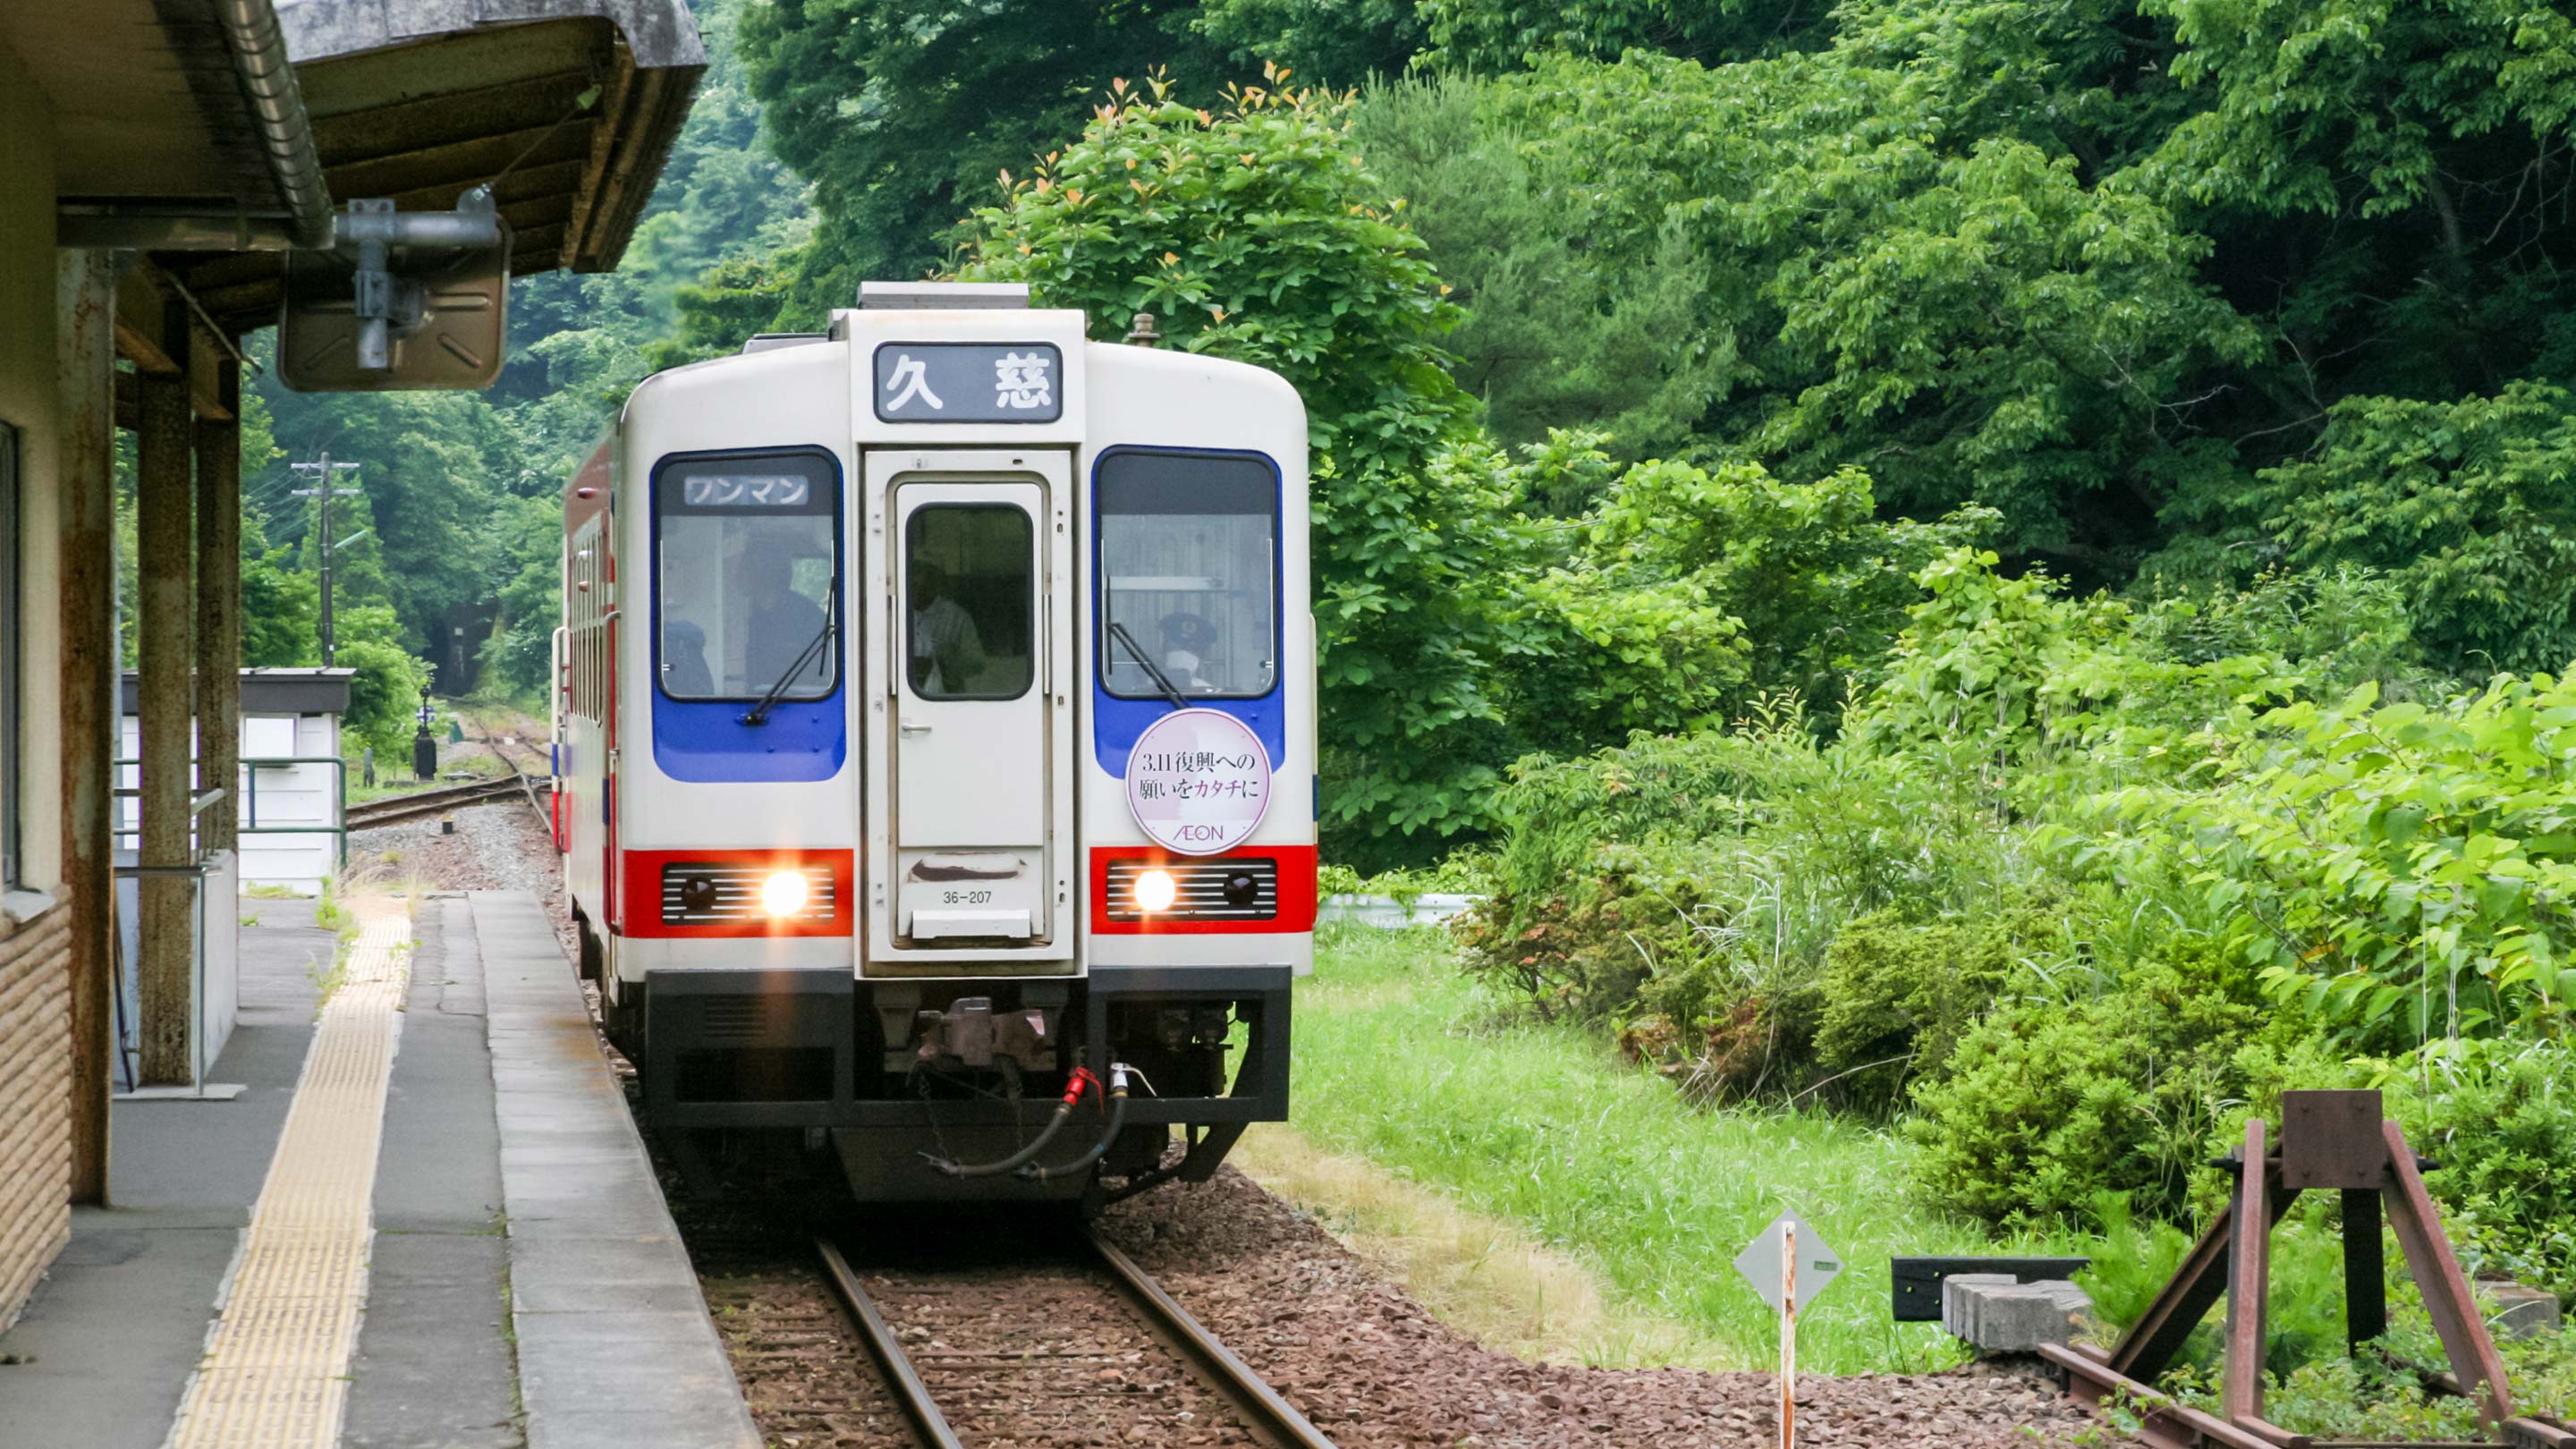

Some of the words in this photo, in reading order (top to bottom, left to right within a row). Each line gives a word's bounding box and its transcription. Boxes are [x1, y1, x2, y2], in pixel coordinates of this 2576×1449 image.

[886, 352, 1052, 411] 久慈
[687, 478, 806, 504] ワンマン
[1142, 750, 1256, 773] 3.11復興への
[1139, 777, 1258, 800] 願いをカタチに
[943, 891, 992, 903] 36-207
